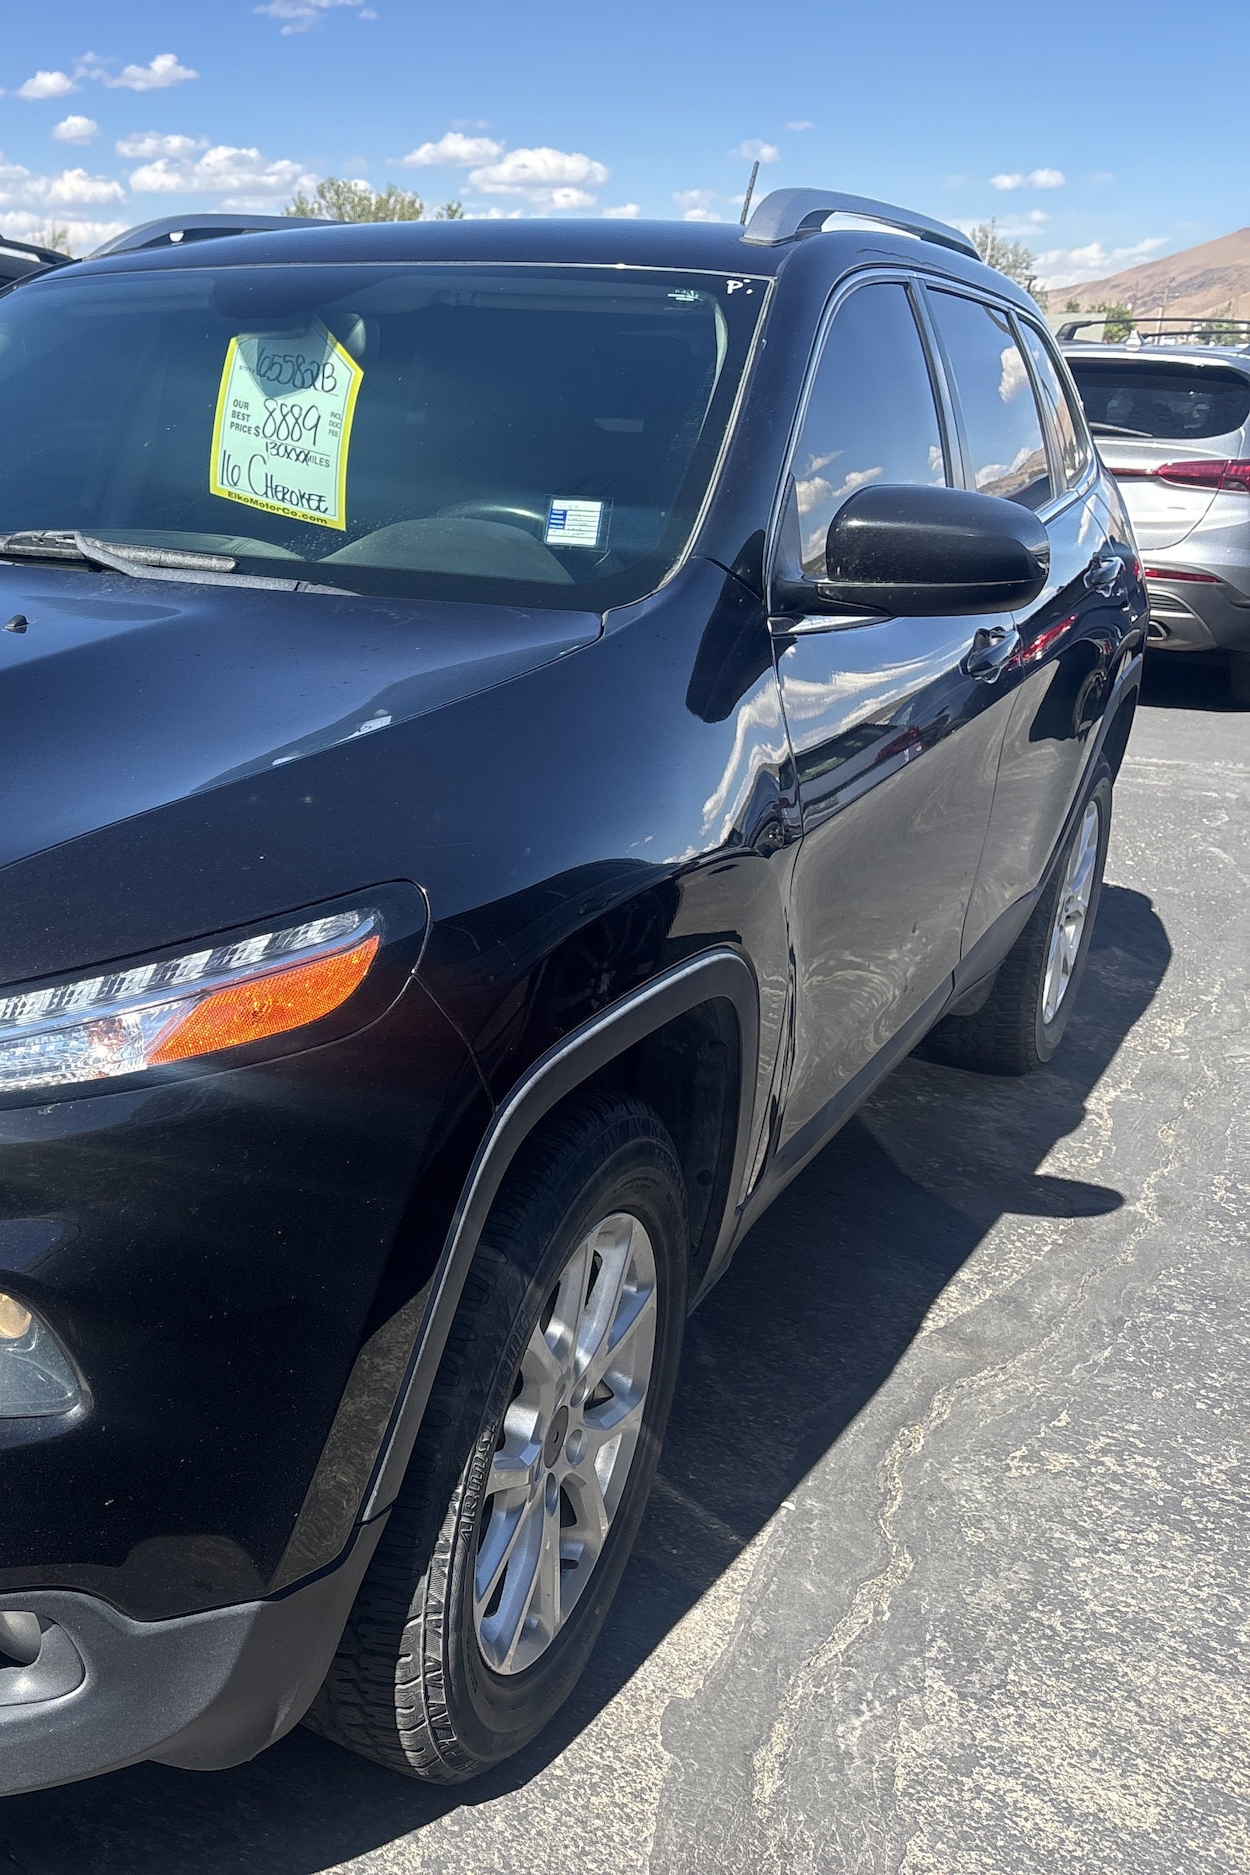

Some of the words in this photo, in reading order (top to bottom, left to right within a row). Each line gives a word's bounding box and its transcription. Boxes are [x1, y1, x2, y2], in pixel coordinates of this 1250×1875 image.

[233, 398, 250, 411] OUR
[231, 409, 251, 423] BEST
[229, 420, 253, 435] PRICE
[306, 454, 330, 469] MILES
[220, 449, 241, 487] 16
[248, 453, 329, 514] CHEROKEE
[227, 490, 328, 525] ElkoMotorCo.com
